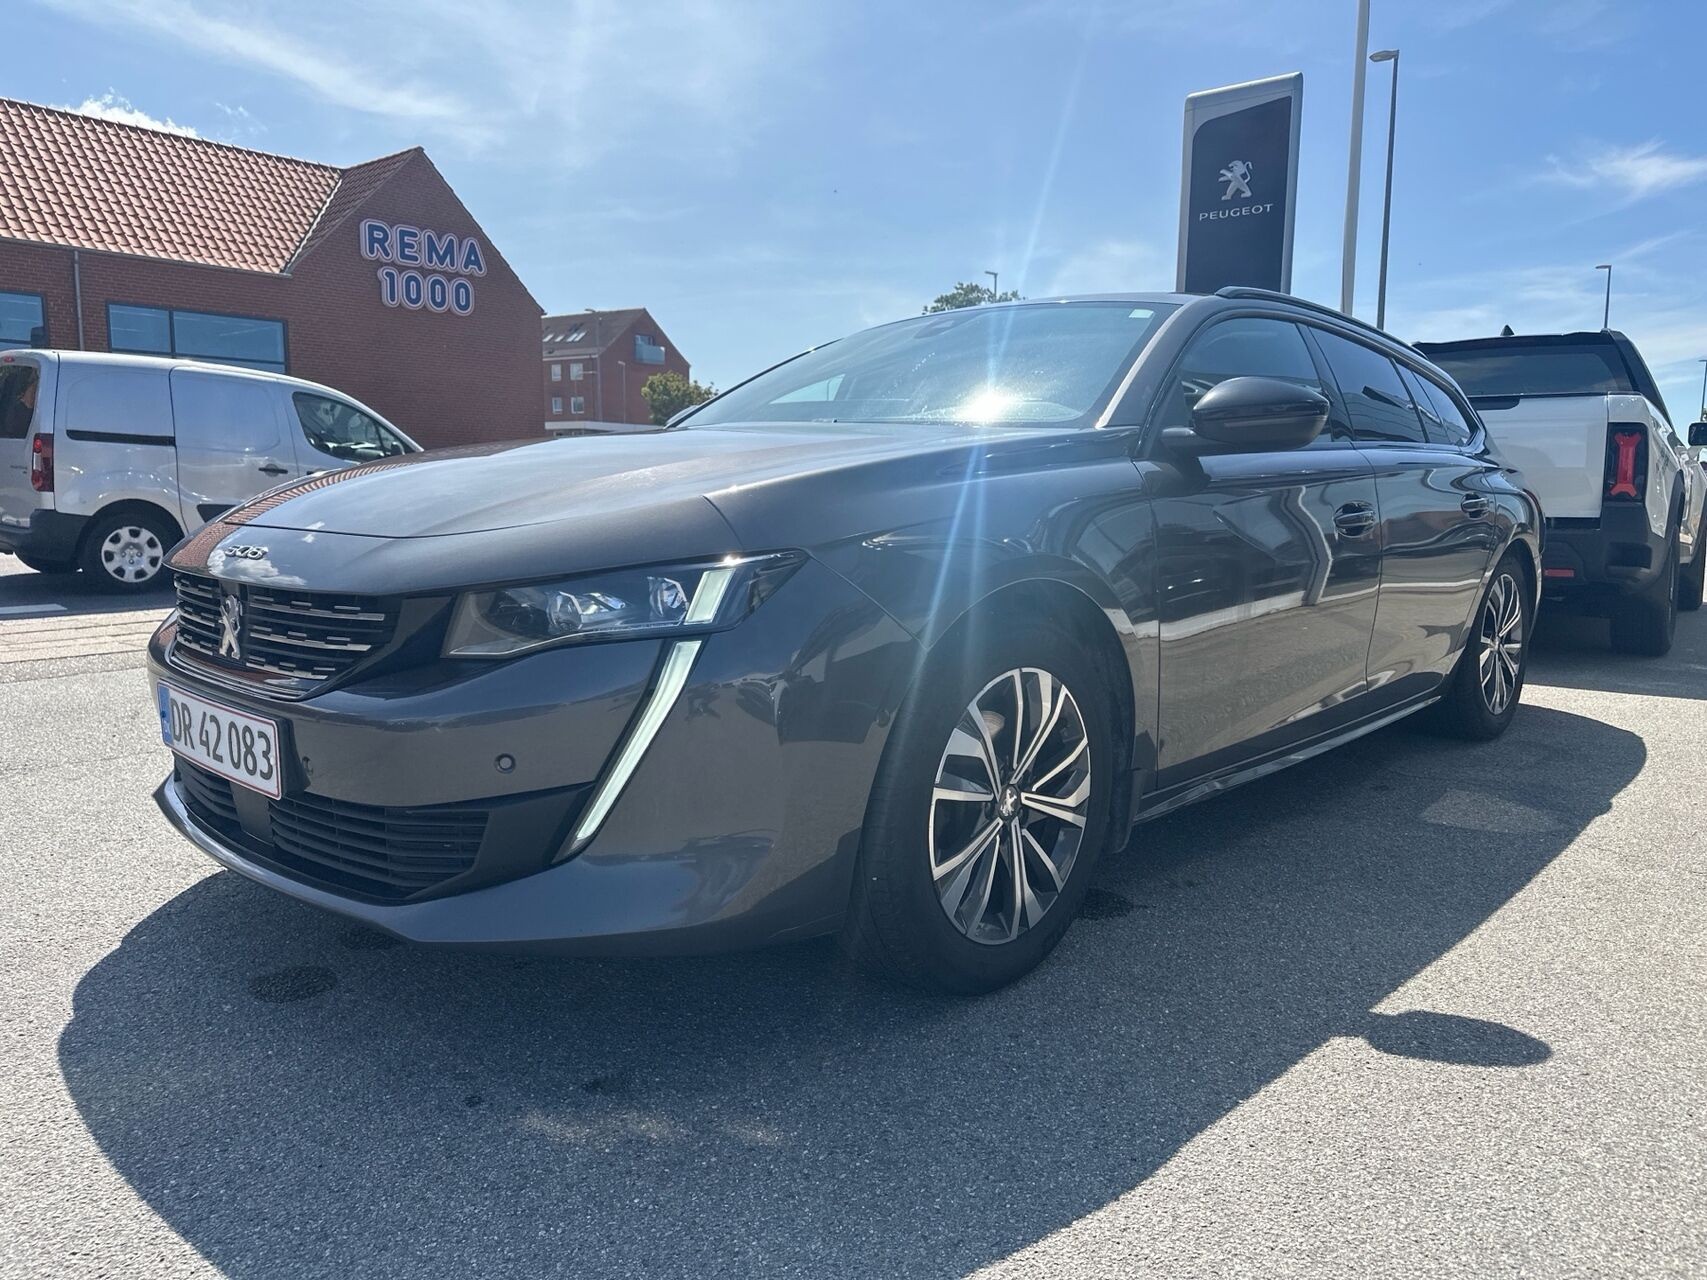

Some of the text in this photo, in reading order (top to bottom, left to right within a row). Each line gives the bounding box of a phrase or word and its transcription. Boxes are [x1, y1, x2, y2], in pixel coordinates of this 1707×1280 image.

[1199, 203, 1274, 221] PEUGEOT
[360, 219, 487, 276] REMA
[378, 266, 474, 316] 1000
[170, 698, 273, 780] DR 42 083
